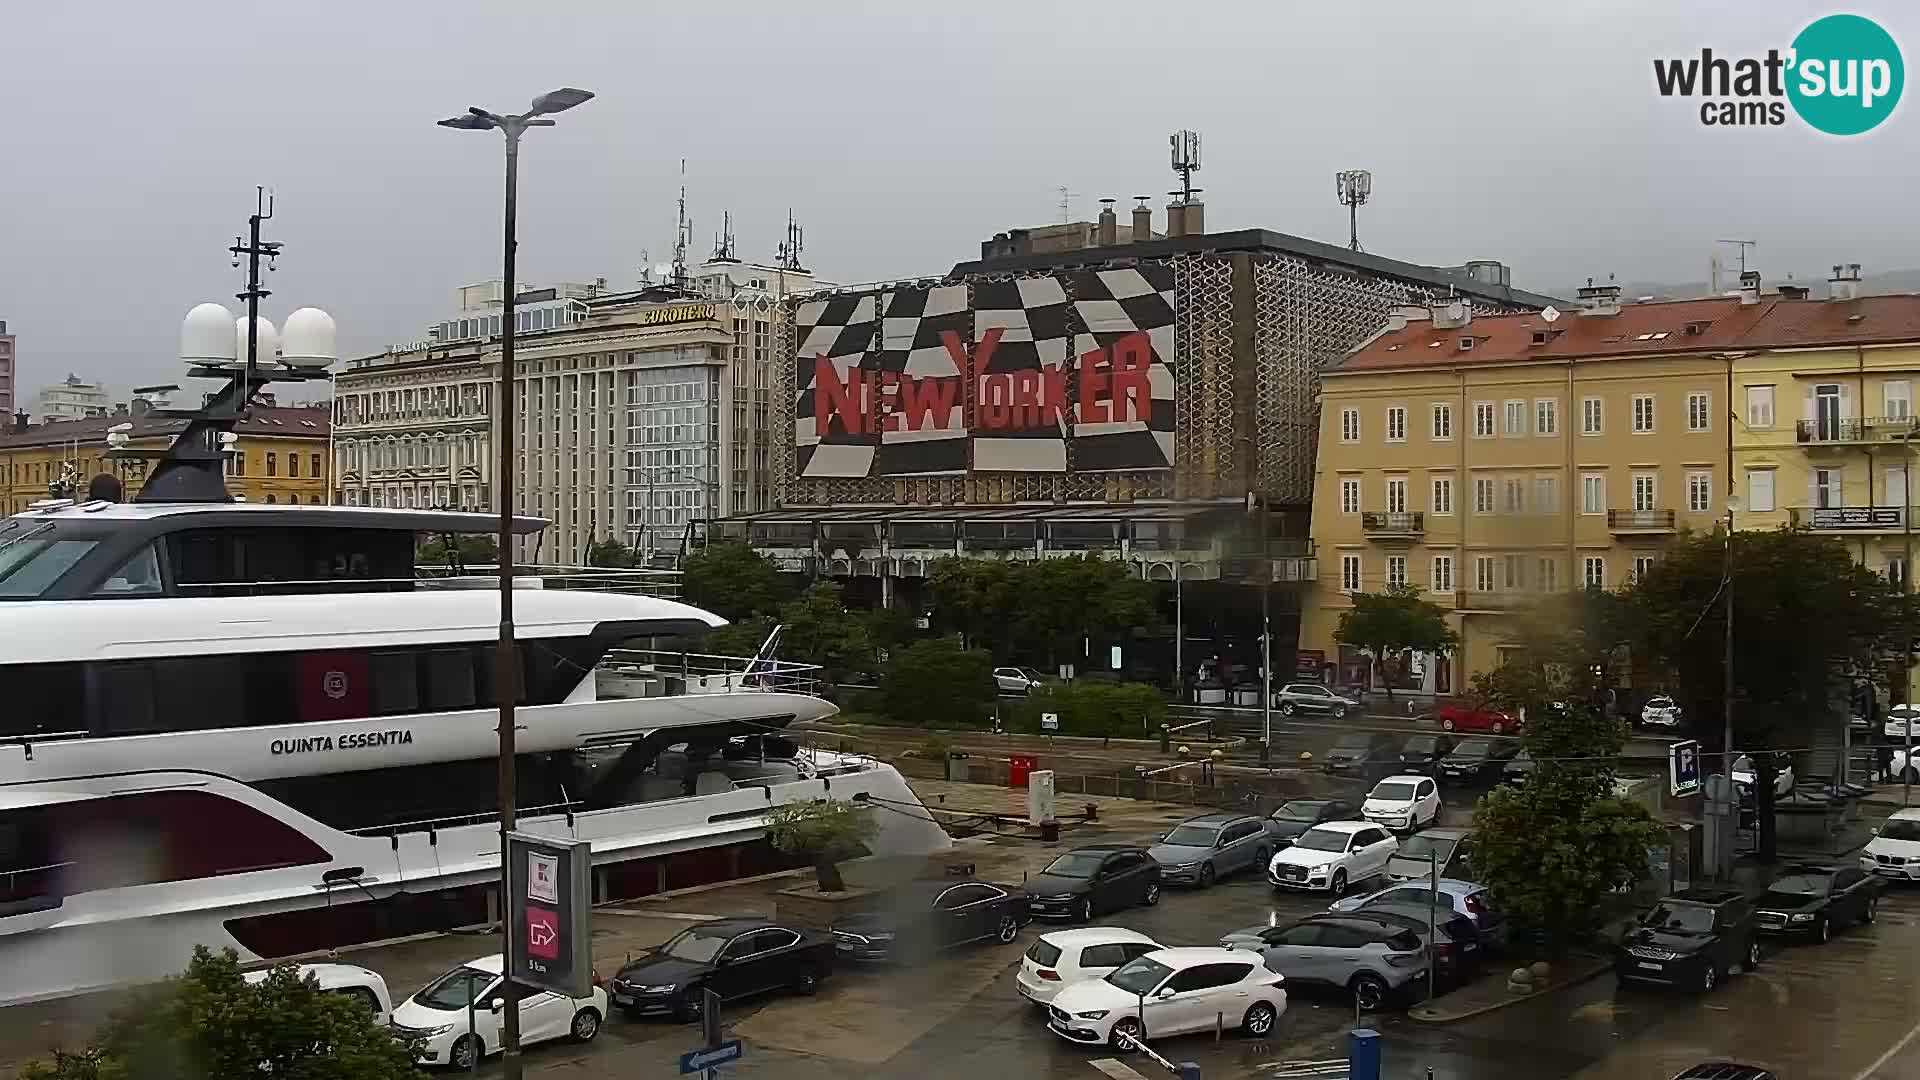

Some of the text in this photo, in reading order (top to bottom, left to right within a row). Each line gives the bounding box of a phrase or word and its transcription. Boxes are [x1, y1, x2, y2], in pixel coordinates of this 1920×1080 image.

[815, 329, 1152, 437] NEW YORKER
[270, 730, 413, 755] QUINTA ESSENTIA
